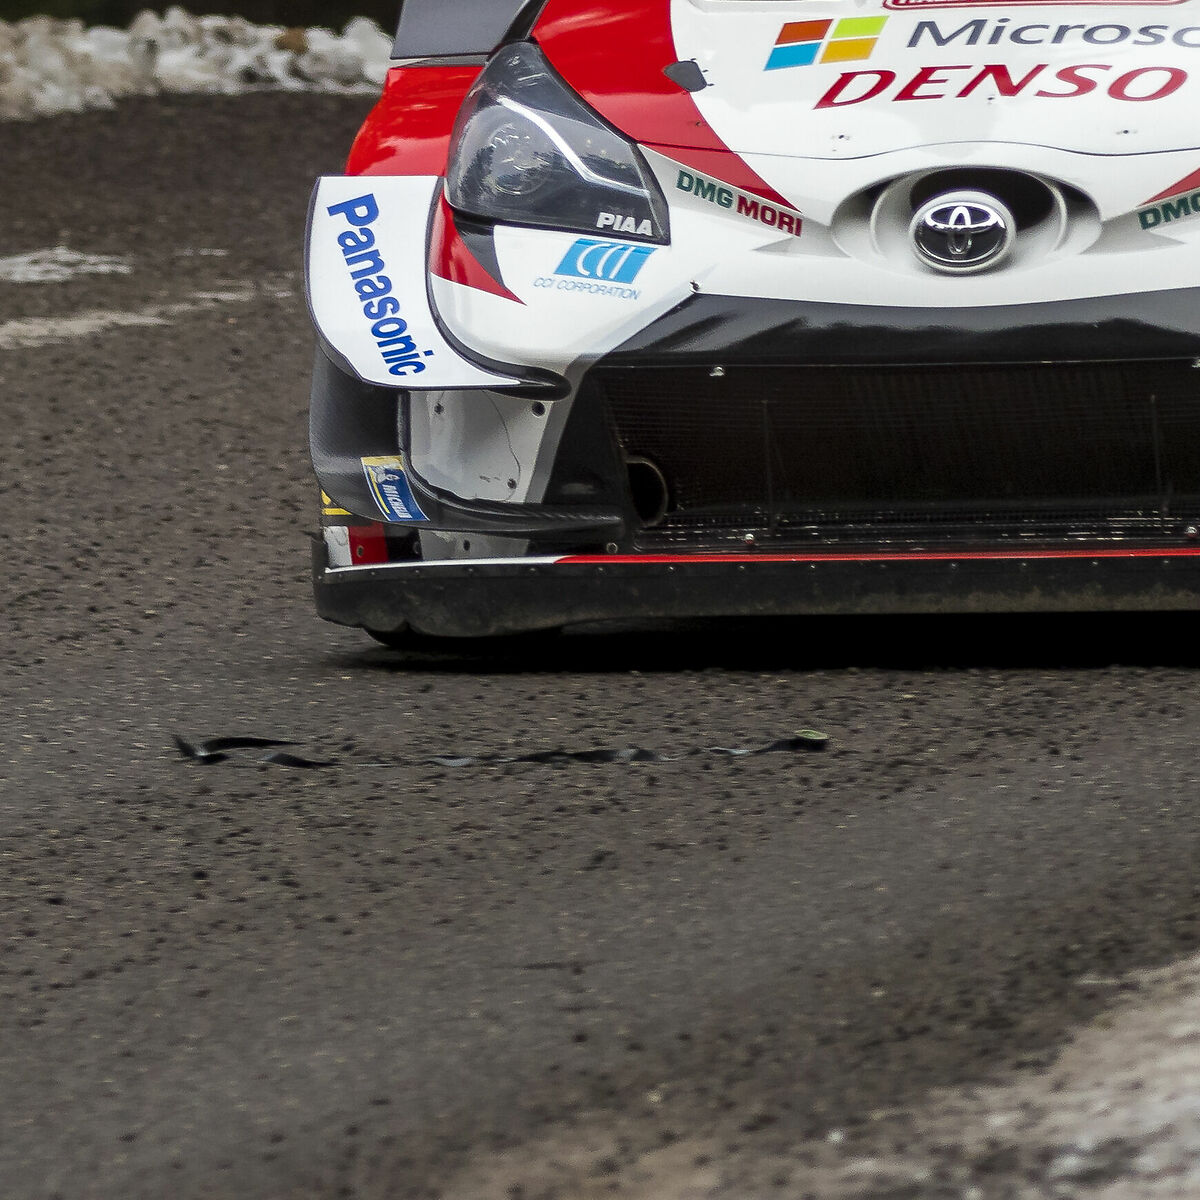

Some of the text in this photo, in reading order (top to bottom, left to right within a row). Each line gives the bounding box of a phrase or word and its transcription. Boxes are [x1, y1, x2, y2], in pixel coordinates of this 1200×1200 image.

[812, 64, 1188, 110] DENSO
[596, 212, 653, 237] PIAA
[676, 169, 803, 237] DMG MORI
[326, 193, 435, 376] Panasonic
[556, 279, 642, 301] CORPORATION
